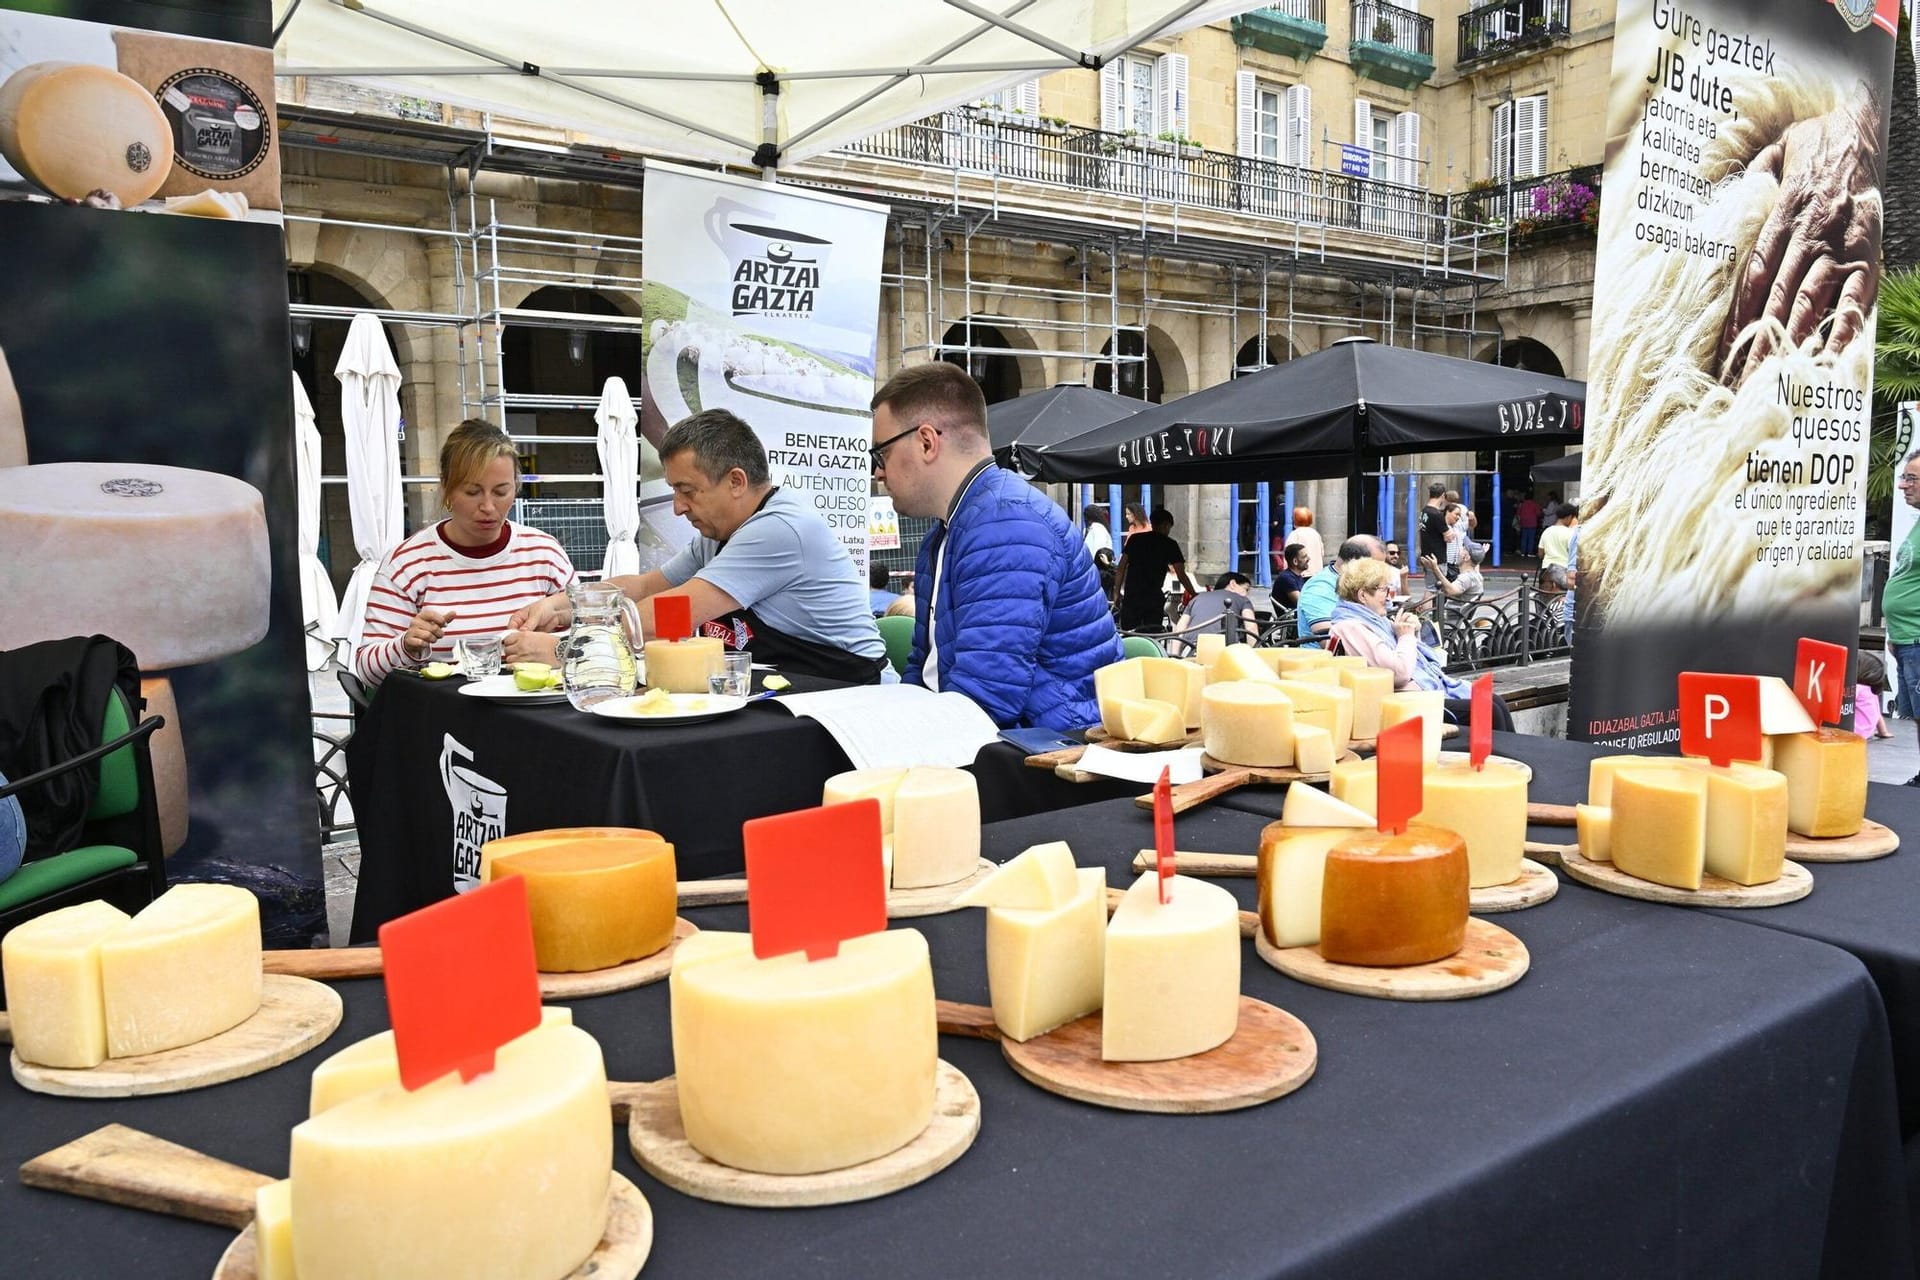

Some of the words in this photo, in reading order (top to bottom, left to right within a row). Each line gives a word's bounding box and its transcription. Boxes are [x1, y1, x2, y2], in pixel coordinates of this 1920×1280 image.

[1653, 0, 1701, 46] Gure
[1706, 28, 1775, 77] gaztek
[1646, 47, 1685, 93] JIB
[1690, 65, 1738, 122] dute,
[1642, 89, 1695, 131] jatorria
[1698, 115, 1717, 140] eta
[1642, 121, 1700, 164] kalitatea
[1640, 152, 1712, 199] bermatzen
[1637, 185, 1693, 222] dizkizun
[1635, 222, 1682, 253] osagai
[1685, 228, 1737, 262] bakarra
[733, 259, 820, 288] ARTZAI
[732, 284, 814, 312] GAZTA
[1777, 372, 1863, 411] Nuestros
[1498, 399, 1582, 434] GURE-TO
[1793, 416, 1861, 448] quesos
[785, 432, 868, 452] BENETAKO
[768, 450, 813, 467] RTZAI
[818, 454, 867, 471] GAZTA
[1746, 450, 1803, 484] tienen
[1810, 453, 1857, 490] DOP,
[782, 472, 867, 493] AUTÉNTICO
[814, 494, 867, 511] QUESO
[1735, 487, 1747, 509] el
[1751, 487, 1782, 510] único
[1786, 489, 1857, 516] ingrediente
[821, 513, 866, 528] STOR
[1756, 520, 1778, 541] que
[1781, 516, 1792, 535] te
[1795, 515, 1855, 541] garantiza
[1757, 541, 1793, 567] origen
[1796, 546, 1804, 566] y
[1807, 540, 1854, 560] calidad
[1807, 659, 1826, 703] K
[1589, 715, 1640, 735] IDIAZABAL
[1640, 711, 1665, 728] GAZTA
[1665, 708, 1681, 724] JAT
[1705, 694, 1730, 739] P
[1637, 728, 1681, 748] REGULADO
[454, 841, 482, 880] GAZ
